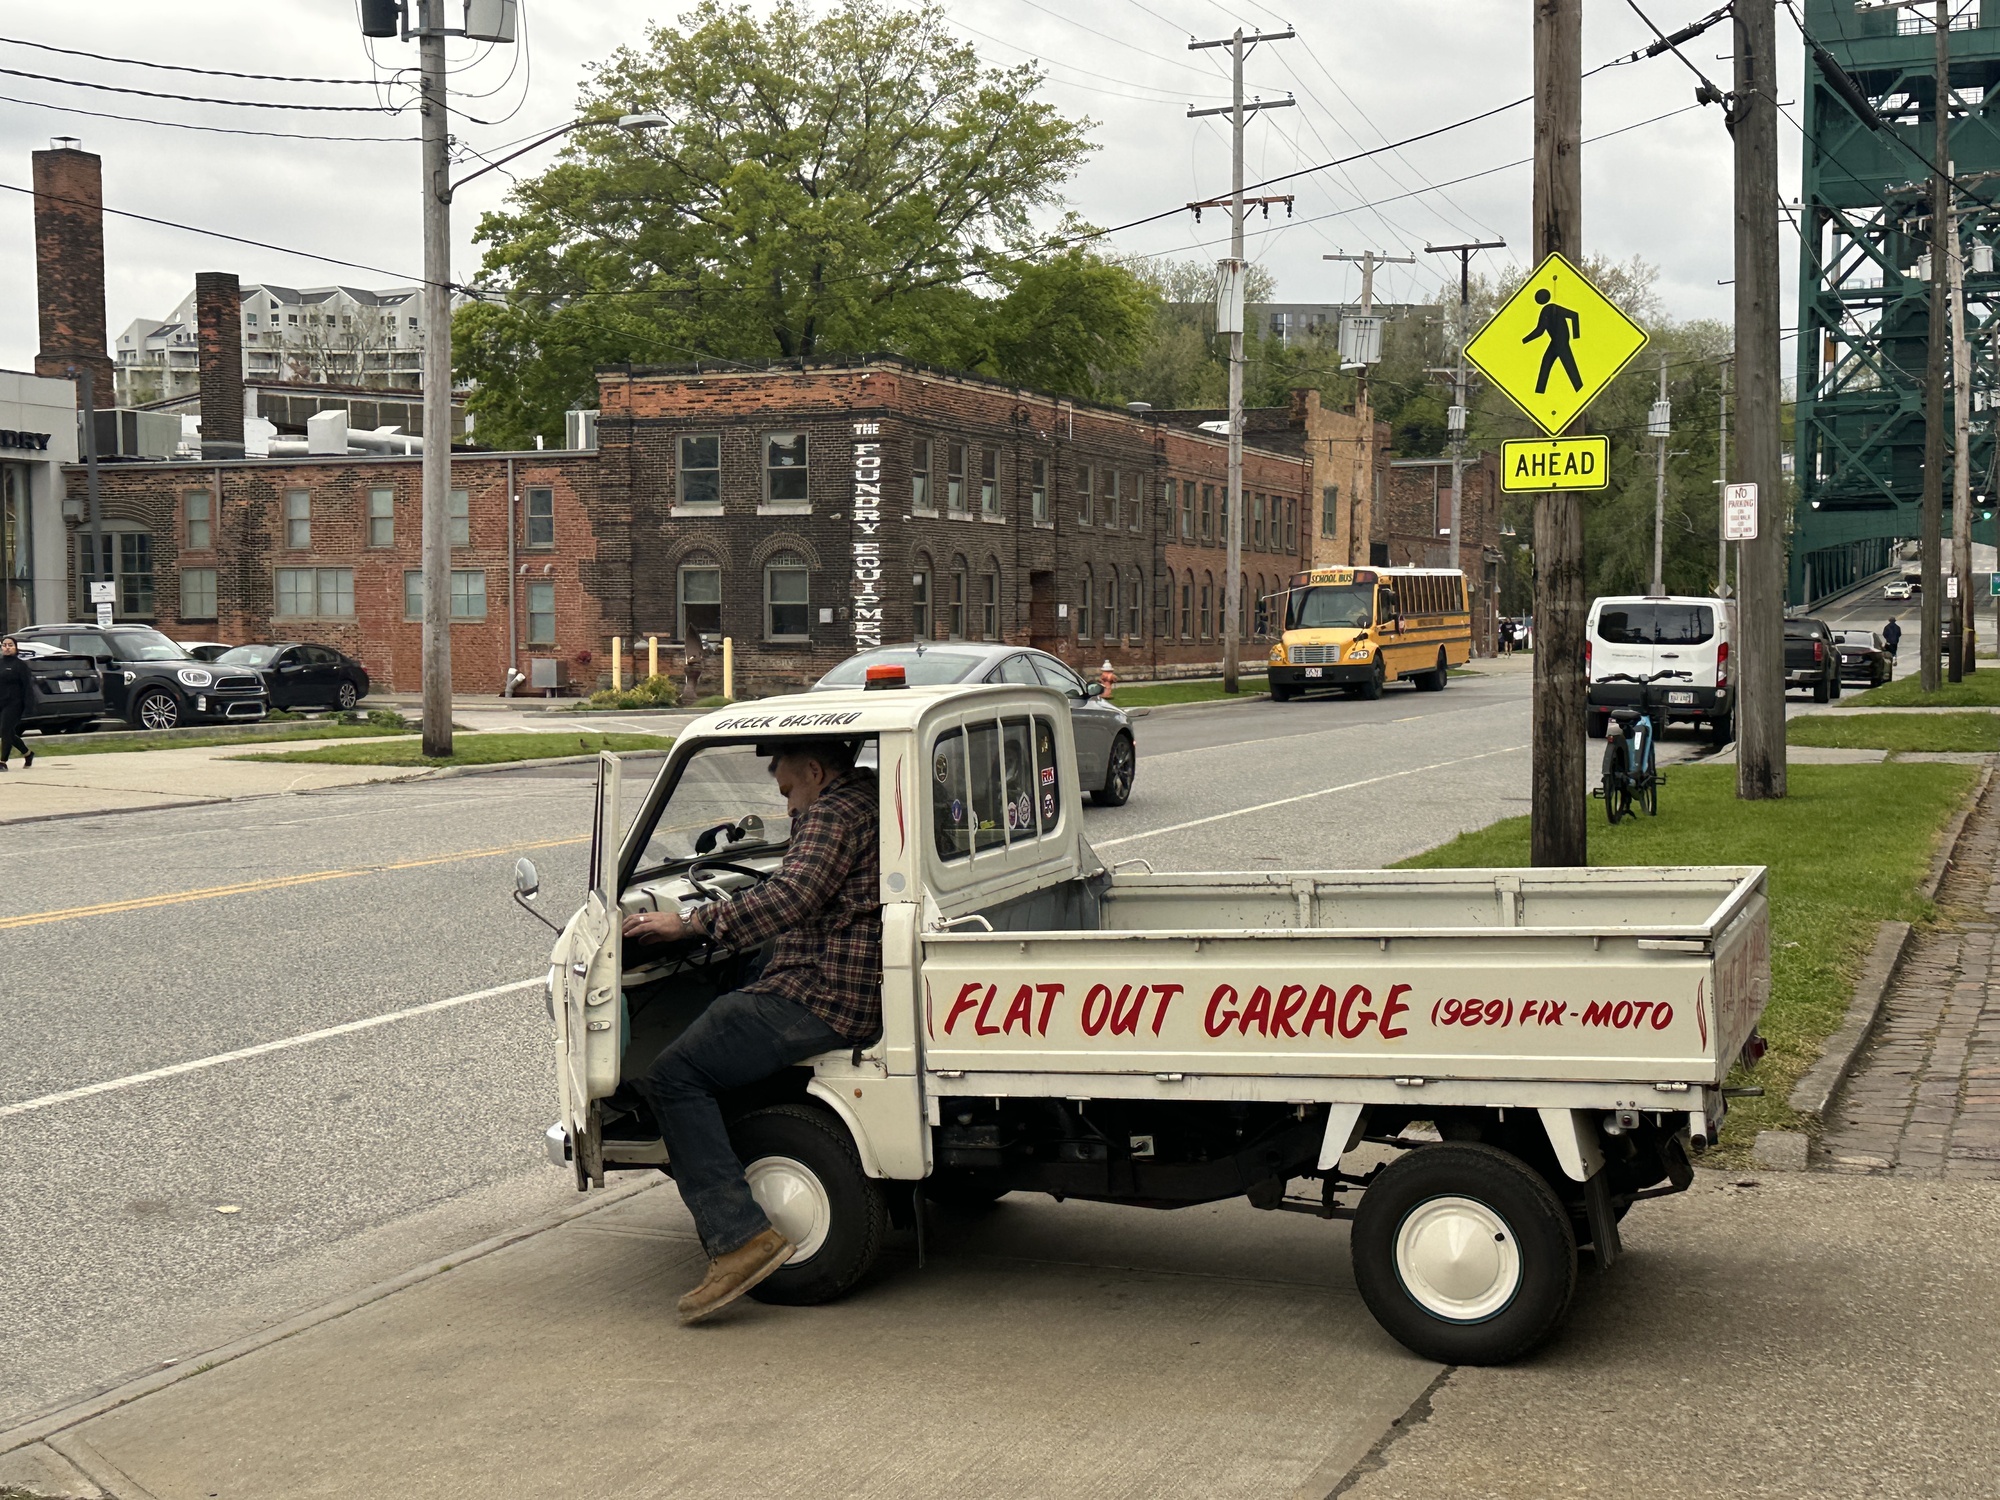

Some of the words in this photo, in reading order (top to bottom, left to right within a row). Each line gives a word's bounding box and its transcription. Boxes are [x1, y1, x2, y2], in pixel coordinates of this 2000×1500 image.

[853, 424, 880, 434] THE
[0, 429, 51, 450] DRY
[1515, 452, 1594, 477] AHEAD
[854, 444, 881, 534] FOUNDRY
[1735, 489, 1747, 498] NO
[1728, 499, 1753, 508] PARKING
[1311, 574, 1337, 583] SCHOOL
[1339, 573, 1353, 582] BUS
[853, 543, 883, 652] EQUIPMEN
[715, 716, 778, 730] GREEK
[779, 712, 863, 728] BASTARD
[944, 983, 1065, 1037] FLAT
[1081, 984, 1184, 1038] OUT
[1204, 983, 1410, 1039] GARAGE
[1431, 998, 1513, 1028] (989)
